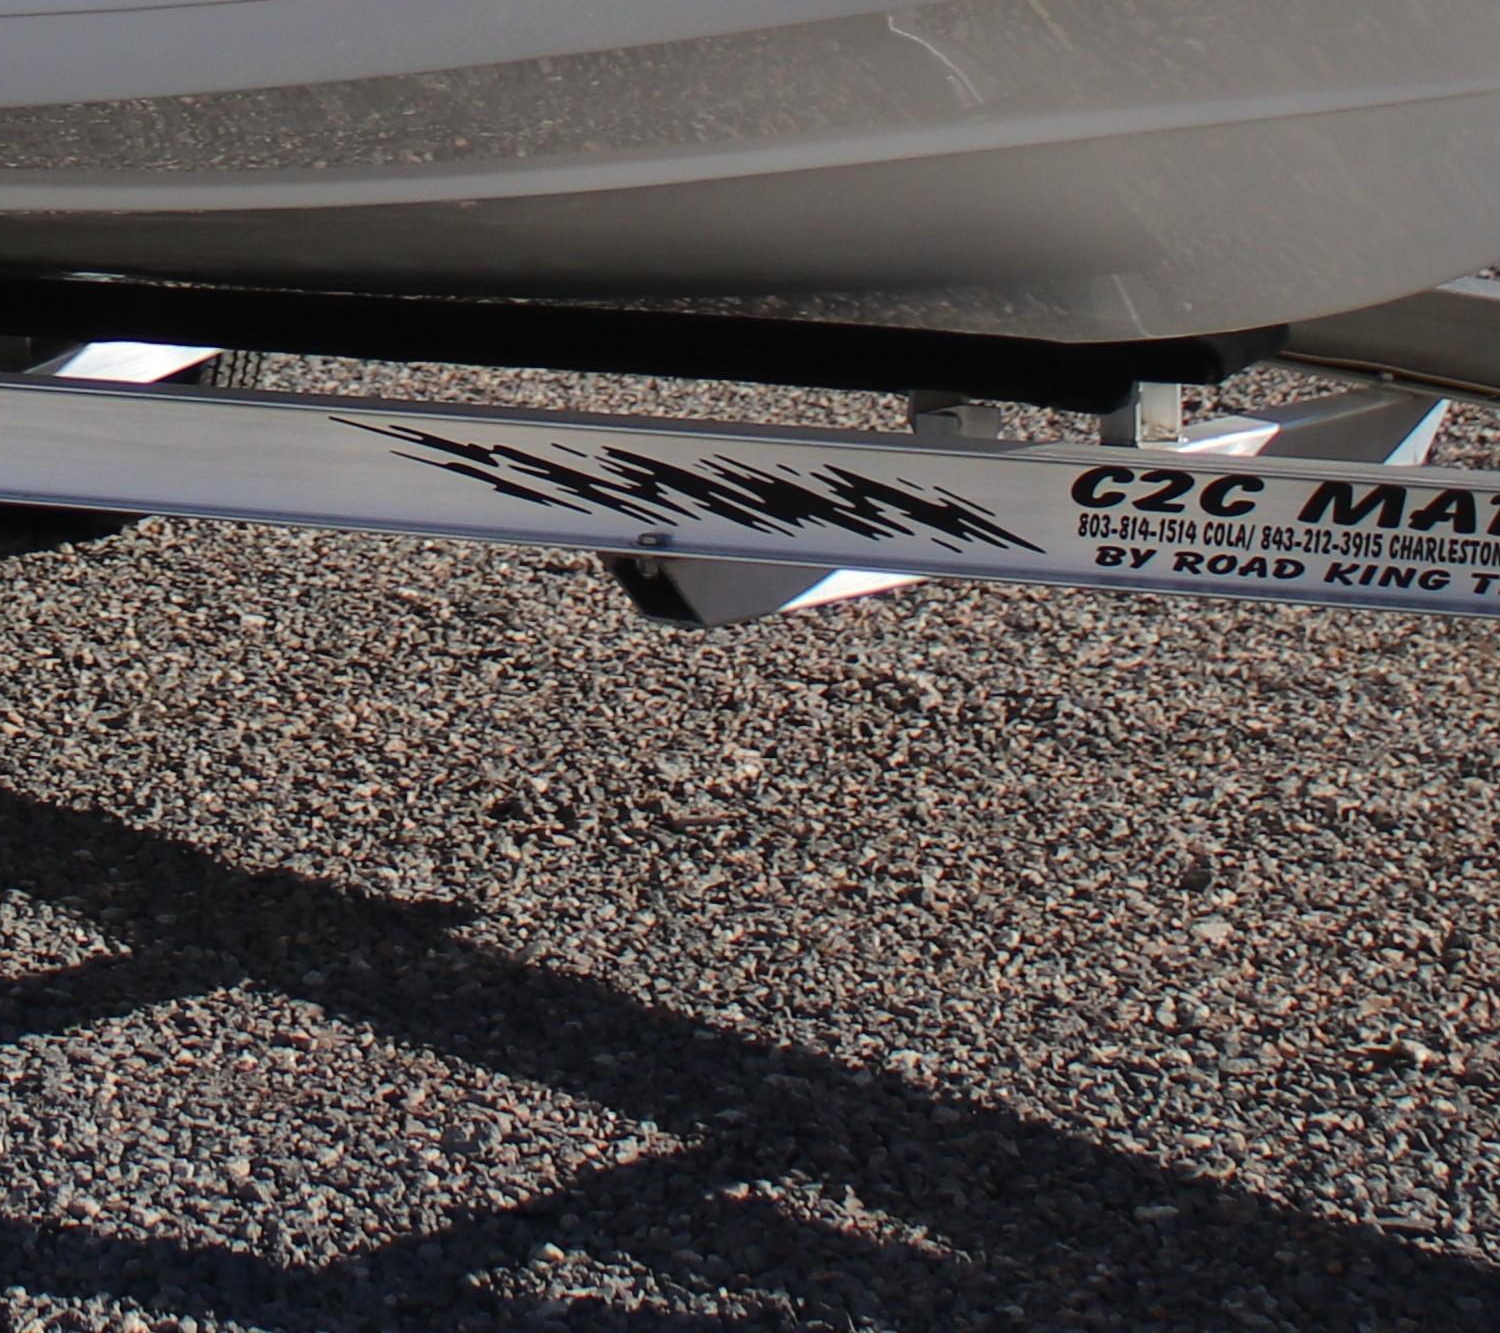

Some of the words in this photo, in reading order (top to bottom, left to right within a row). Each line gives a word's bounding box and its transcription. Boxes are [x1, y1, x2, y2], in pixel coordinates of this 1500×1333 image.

[1071, 465, 1265, 518] C2C
[1078, 512, 1197, 545] 803-814-1514
[1202, 521, 1256, 551] COLA/
[1260, 525, 1384, 559] 843-212-3915
[1095, 545, 1157, 569] BY
[1172, 551, 1305, 580] ROAD
[1323, 562, 1451, 591] KING
